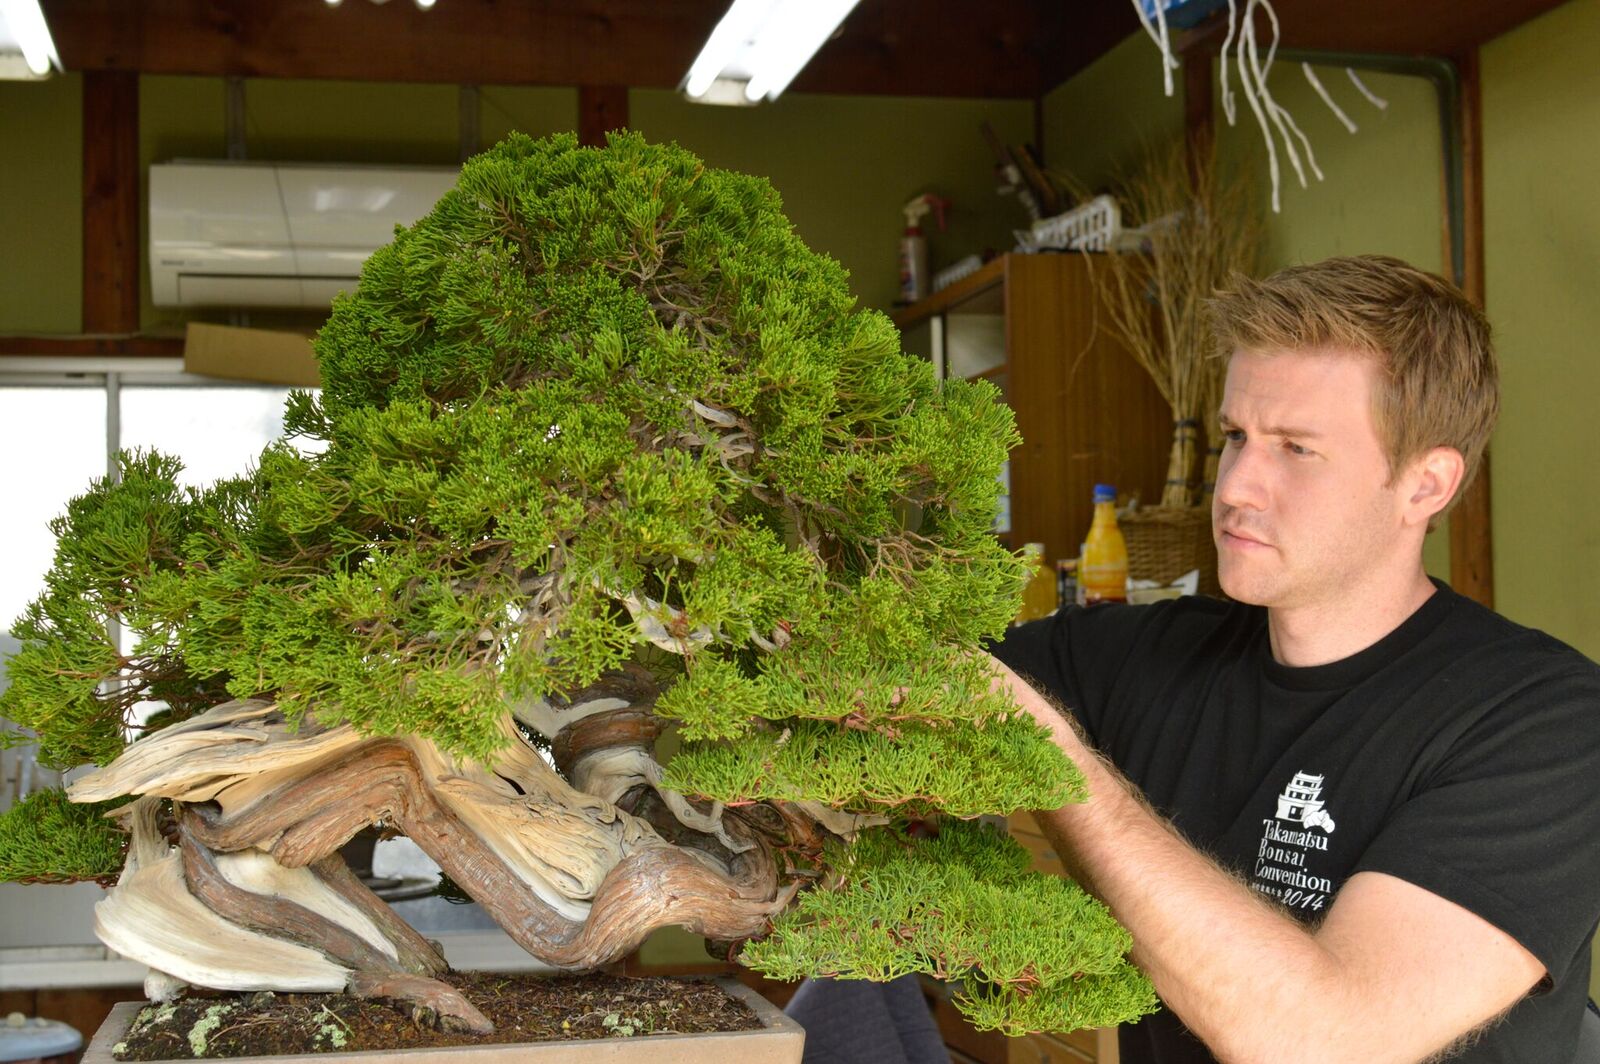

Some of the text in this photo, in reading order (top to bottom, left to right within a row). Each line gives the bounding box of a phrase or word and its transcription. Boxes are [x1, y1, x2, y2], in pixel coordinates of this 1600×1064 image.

[1262, 819, 1328, 851] Takamatsu
[1258, 838, 1307, 867] Bonsai
[1254, 857, 1331, 893] Convention
[1280, 888, 1325, 910] 2014
